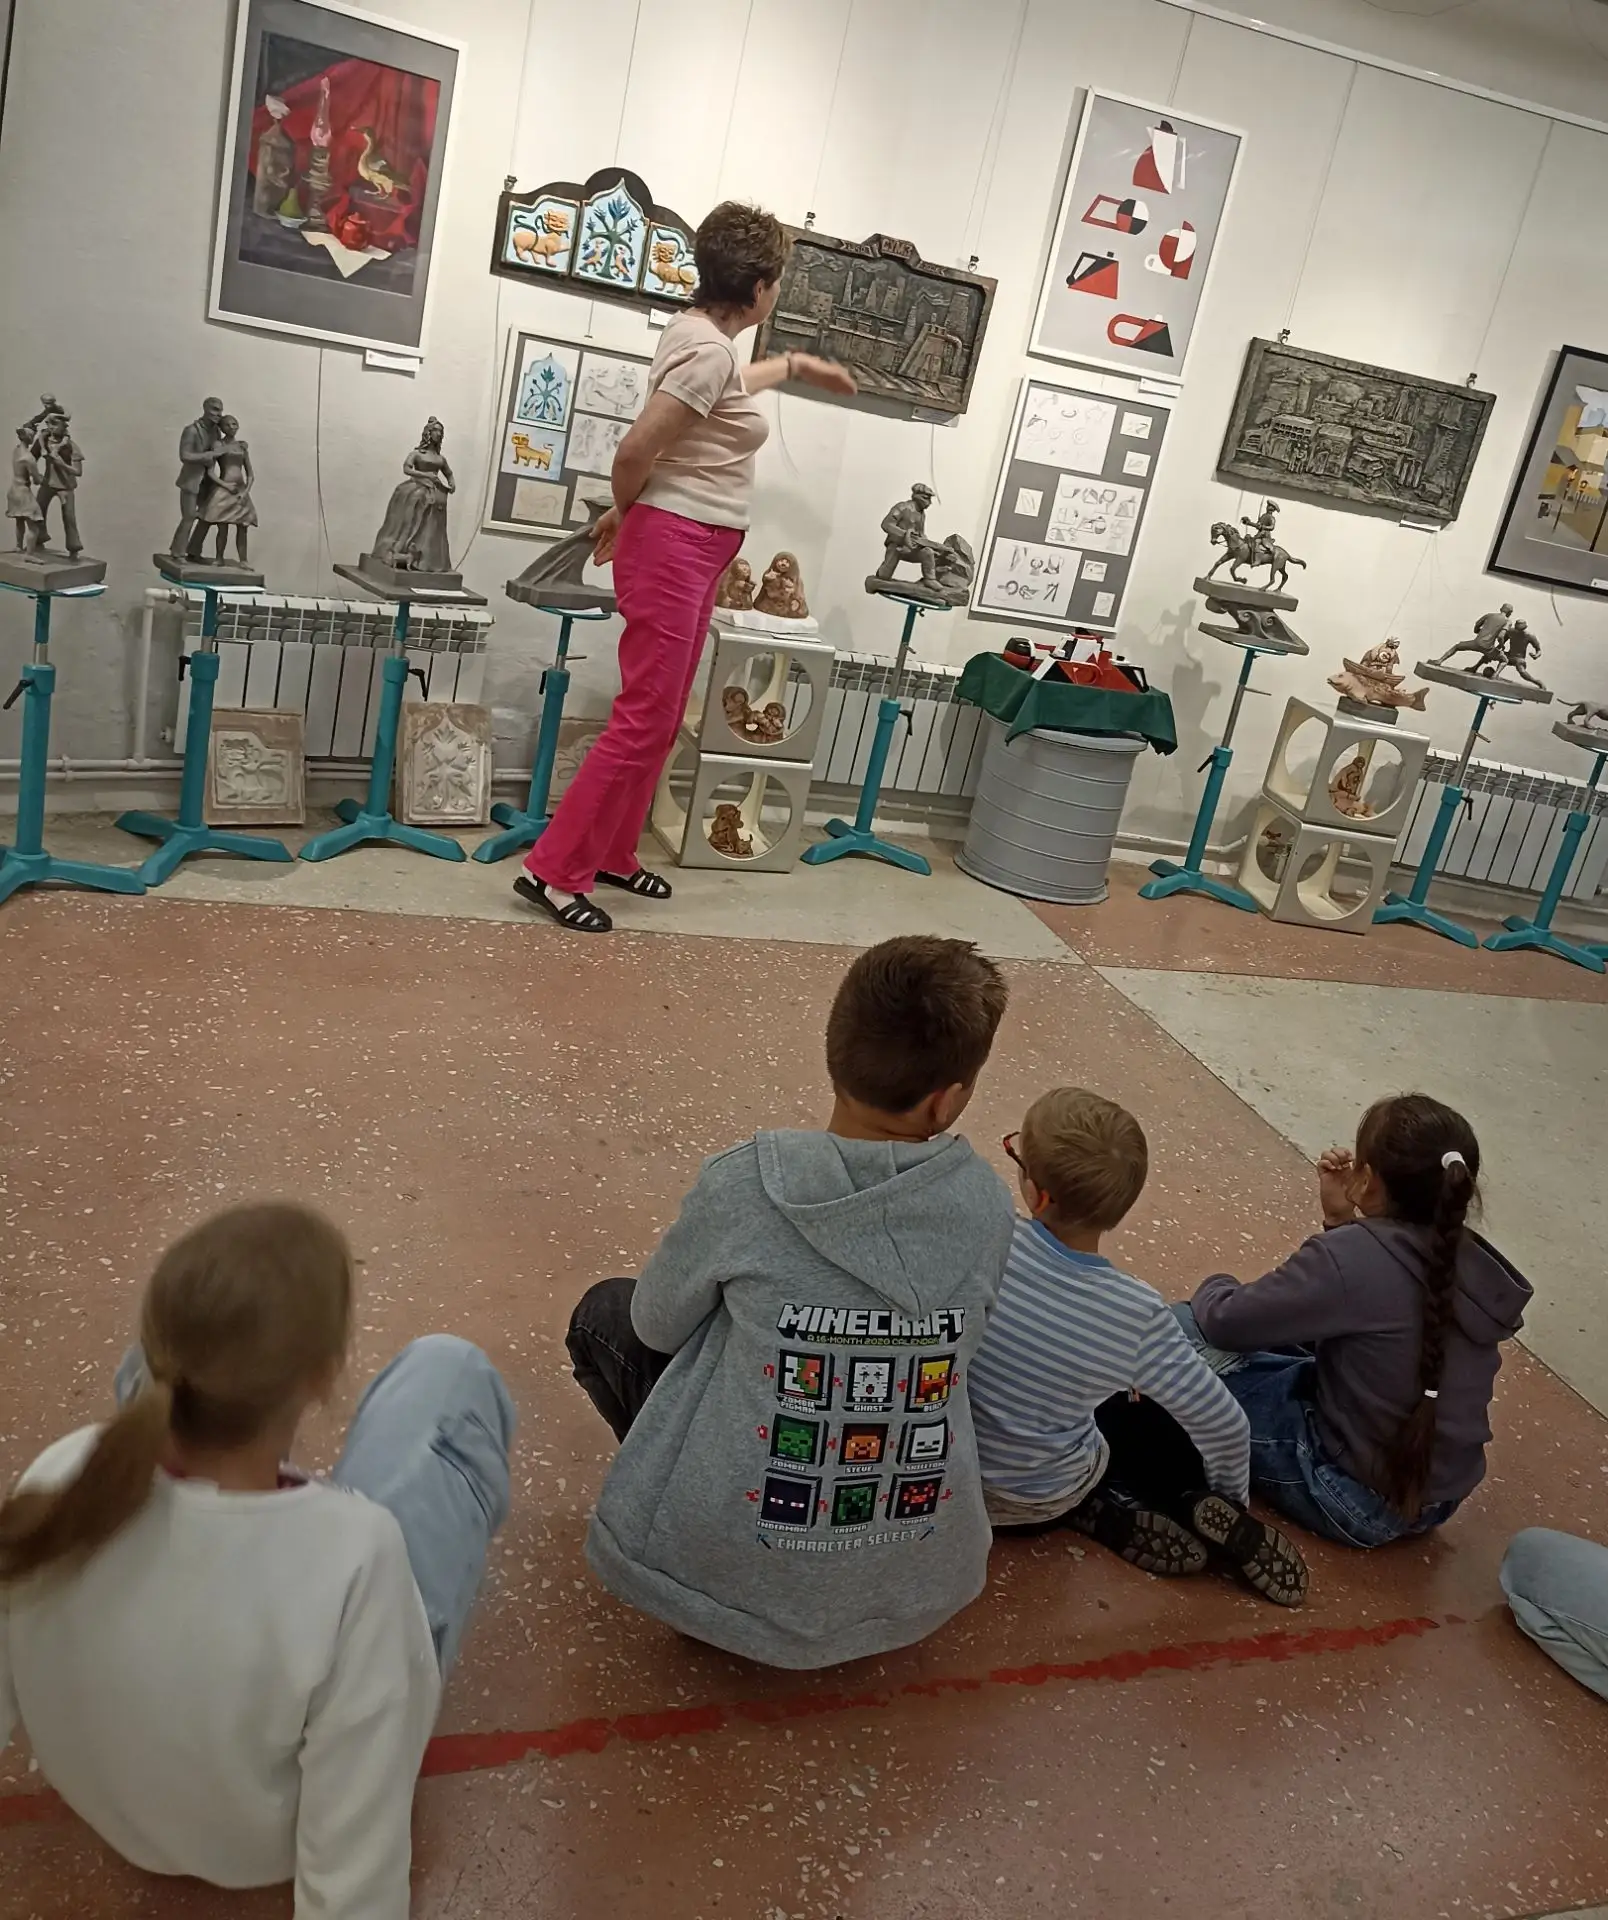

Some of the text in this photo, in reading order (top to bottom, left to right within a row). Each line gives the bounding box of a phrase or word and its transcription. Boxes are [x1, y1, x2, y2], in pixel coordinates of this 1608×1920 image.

[777, 1303, 966, 1338] MINECRAFT
[864, 1337, 890, 1345] 2020
[853, 1404, 884, 1412] GHAST
[771, 1460, 806, 1472] ZOMBIE
[845, 1465, 873, 1473] STEVE
[777, 1529, 918, 1553] CHARACTER SELECT
